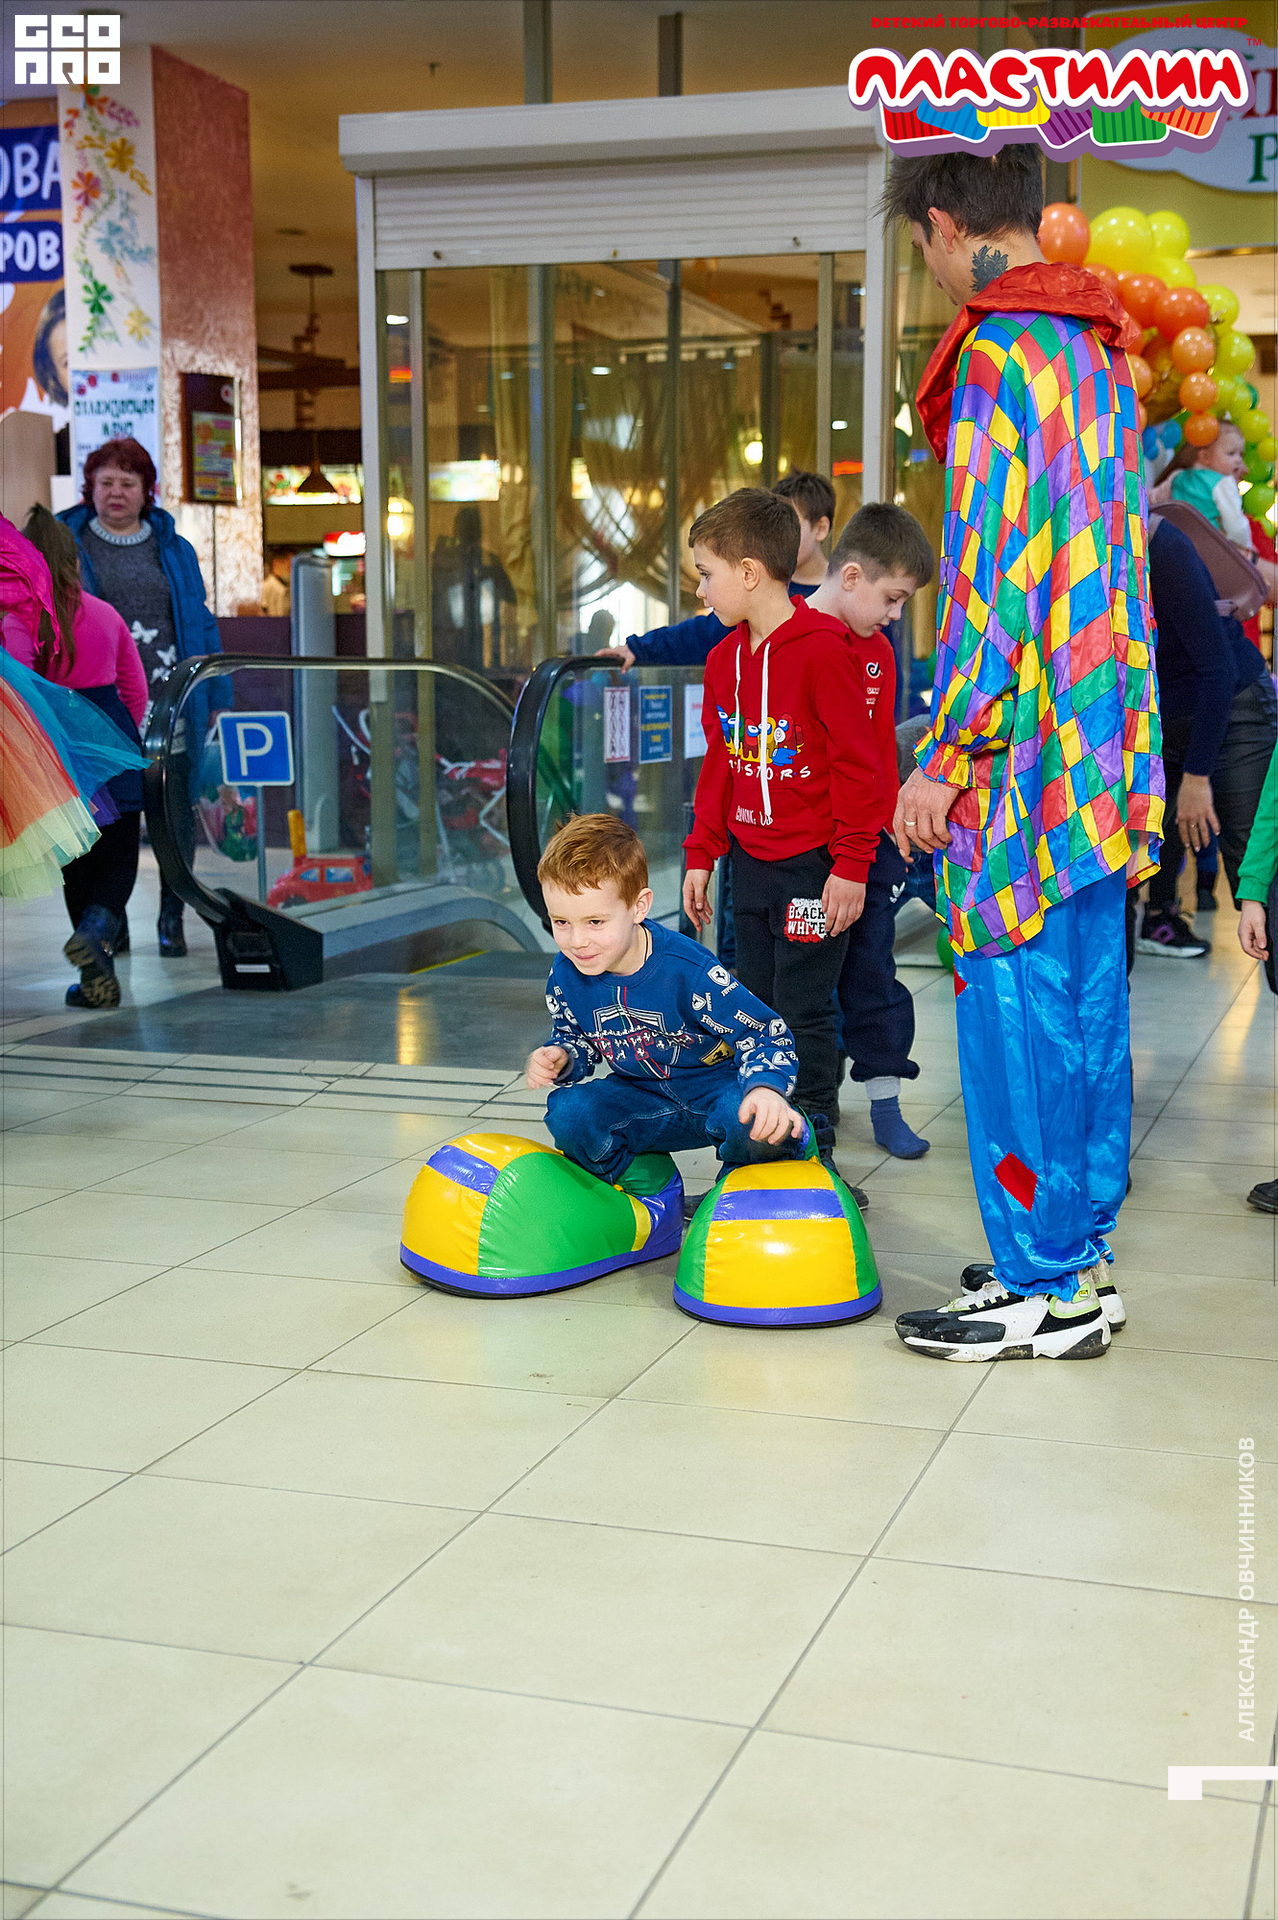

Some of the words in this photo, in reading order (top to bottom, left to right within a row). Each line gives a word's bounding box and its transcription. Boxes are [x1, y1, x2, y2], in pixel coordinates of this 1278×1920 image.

[236, 722, 273, 776] P
[788, 905, 826, 920] BLACK
[787, 921, 826, 935] WHITE
